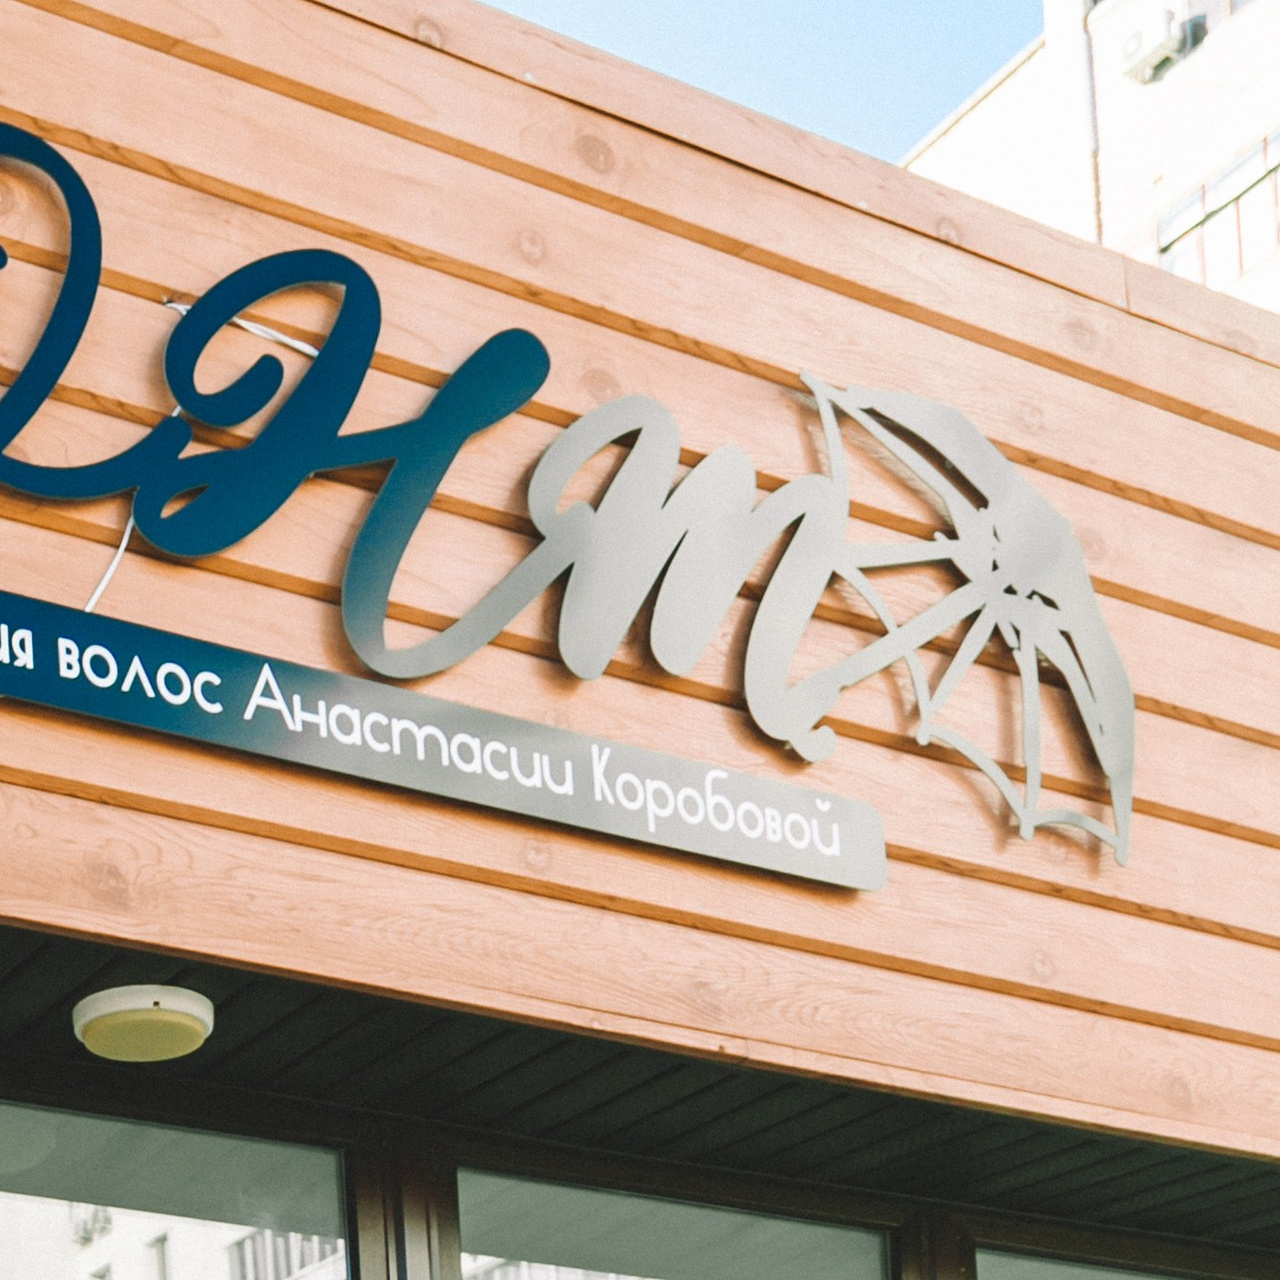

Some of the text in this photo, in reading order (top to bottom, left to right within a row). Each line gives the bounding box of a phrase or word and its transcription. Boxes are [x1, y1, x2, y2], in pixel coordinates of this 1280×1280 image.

[57, 637, 223, 714] волос
[243, 662, 574, 797] Анастасии
[590, 744, 841, 857] Коробовой
